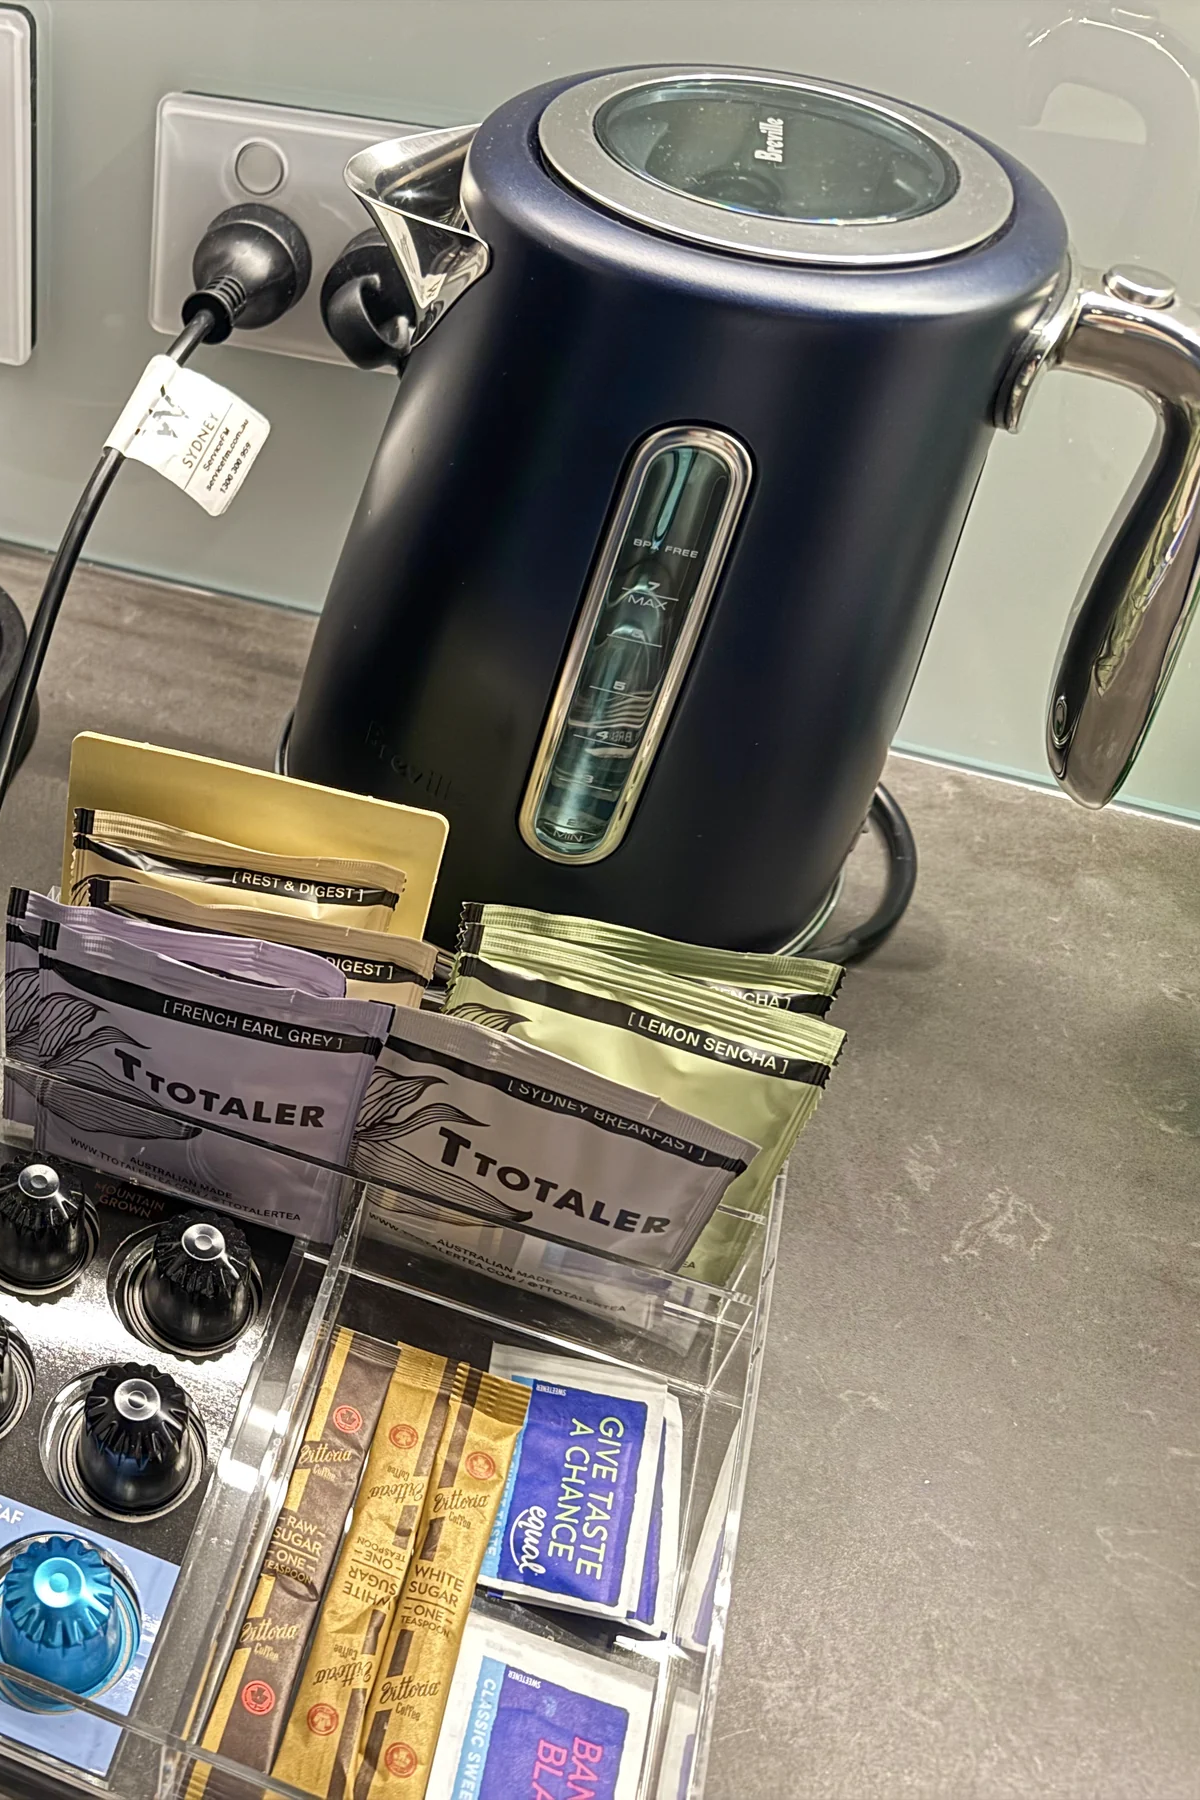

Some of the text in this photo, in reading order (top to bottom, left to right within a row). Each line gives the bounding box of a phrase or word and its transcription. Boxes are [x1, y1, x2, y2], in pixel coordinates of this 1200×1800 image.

[754, 117, 784, 162] Breville
[182, 412, 220, 470] SYDNEY
[219, 473, 234, 494] 1300
[232, 458, 243, 475] 300
[664, 545, 698, 558] FREE
[628, 594, 668, 610] MAX
[613, 681, 626, 690] 5
[596, 731, 608, 740] 4
[553, 829, 583, 842] MIN
[241, 872, 280, 889] REST
[299, 882, 354, 899] DIGEST
[709, 985, 780, 1008] NCHA
[173, 1002, 238, 1029] FRENCH
[242, 1019, 283, 1040] EARL
[288, 1029, 334, 1048] GREY
[638, 1015, 701, 1047] LEMON
[703, 1037, 777, 1070] SENCHA
[130, 1156, 233, 1199] AUSTRALIAN MADE
[94, 1182, 165, 1212] MOUNTAIN
[99, 1194, 152, 1219] GROWN
[437, 1238, 553, 1285] AUSTRALIAN MADE
[536, 1383, 567, 1397] SWEETENER
[300, 1443, 353, 1464] Vittoria
[367, 1482, 425, 1504] Vittoria
[433, 1489, 491, 1513] Vittoria
[548, 1417, 595, 1562] A CHANCE
[576, 1416, 625, 1580] GIVE TASTE
[449, 1511, 472, 1530] Coffee
[273, 1526, 323, 1557] SUGAR
[356, 1535, 406, 1563] TEASPOON
[517, 1505, 548, 1575] equal
[264, 1558, 313, 1585] TEASPOON
[348, 1565, 399, 1597] SUGAR
[415, 1564, 464, 1593] WHITE
[342, 1580, 392, 1610] WHITE
[408, 1580, 460, 1608] SUGAR
[241, 1618, 298, 1643] Vittoria
[401, 1615, 450, 1638] TEASPOON
[254, 1642, 279, 1661] Coffee
[333, 1643, 359, 1661] Coffee
[313, 1661, 373, 1687] Vittoria
[507, 1669, 542, 1690] SWEETENER
[380, 1675, 442, 1705] Vittoria
[395, 1701, 421, 1722] Coffee
[474, 1678, 497, 1748] CLASSIC
